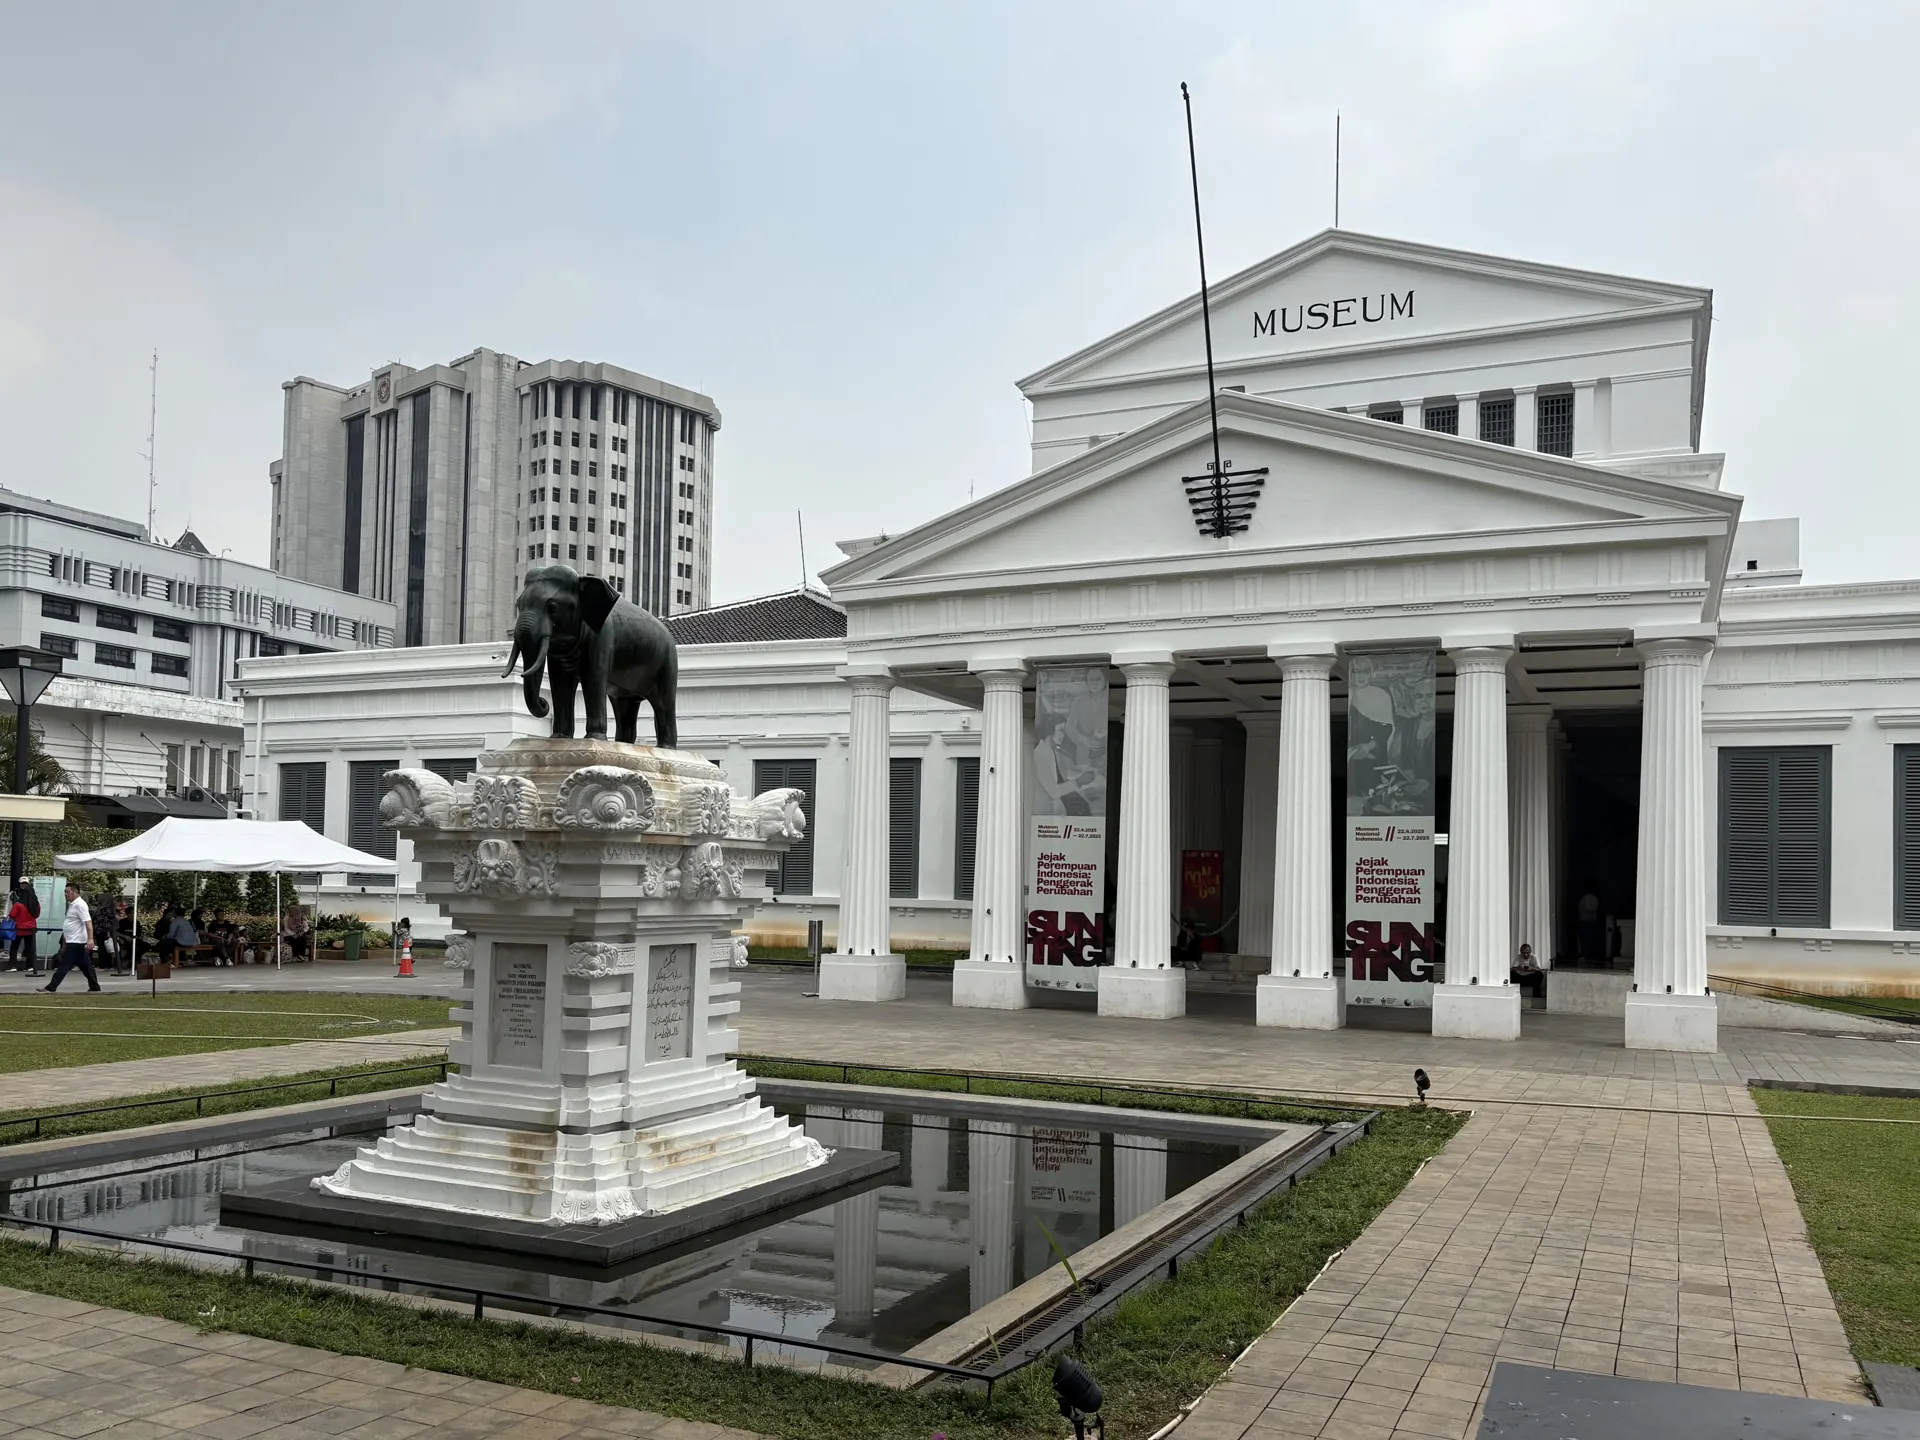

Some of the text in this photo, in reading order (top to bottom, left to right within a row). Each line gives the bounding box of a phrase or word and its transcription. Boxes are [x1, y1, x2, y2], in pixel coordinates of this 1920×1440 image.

[1253, 290, 1415, 338] MUSEUM
[1037, 852, 1066, 863] Jejak
[1355, 856, 1389, 868] Jejak
[1037, 861, 1097, 872] Perempuan
[1355, 866, 1425, 877] Perempuan
[1037, 869, 1091, 879] Indonesia:
[1036, 877, 1093, 889] Penggerak
[1355, 876, 1419, 885] Indonesia:
[1036, 886, 1093, 896] Perubahan
[1355, 885, 1421, 896] Penggerak
[1355, 894, 1421, 904] Perubahan
[1027, 909, 1104, 940] SUN
[1346, 919, 1435, 952] SUN
